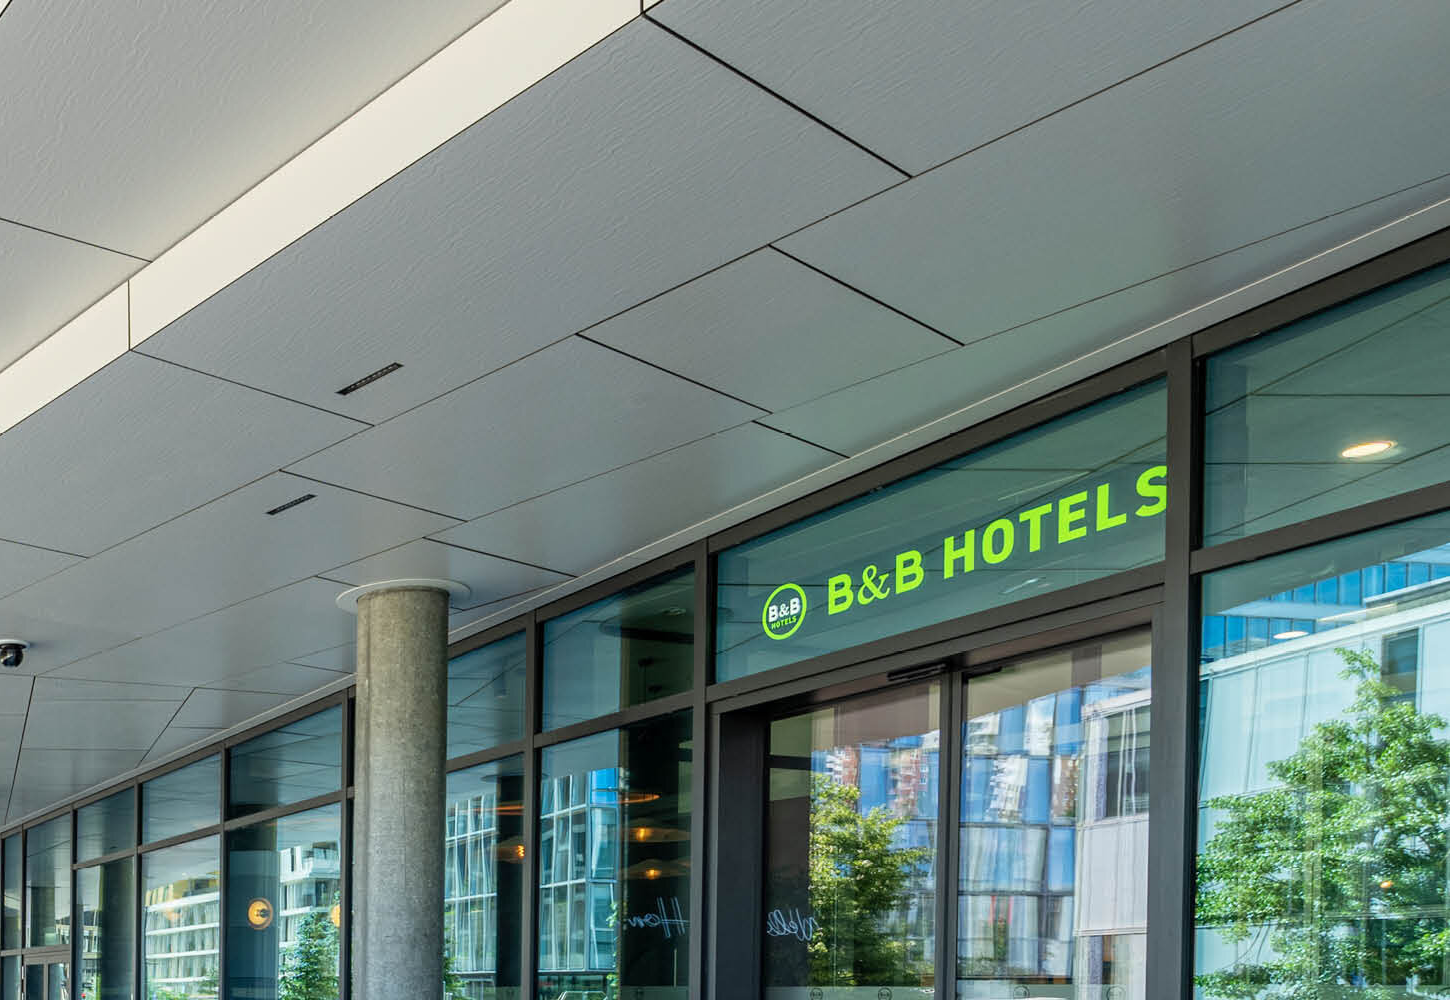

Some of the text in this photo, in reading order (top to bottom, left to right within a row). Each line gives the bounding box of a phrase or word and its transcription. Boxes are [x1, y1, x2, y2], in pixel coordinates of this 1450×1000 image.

[828, 465, 1168, 616] B&B HOTELS
[769, 597, 801, 623] B&B
[771, 615, 797, 630] HOTELS
